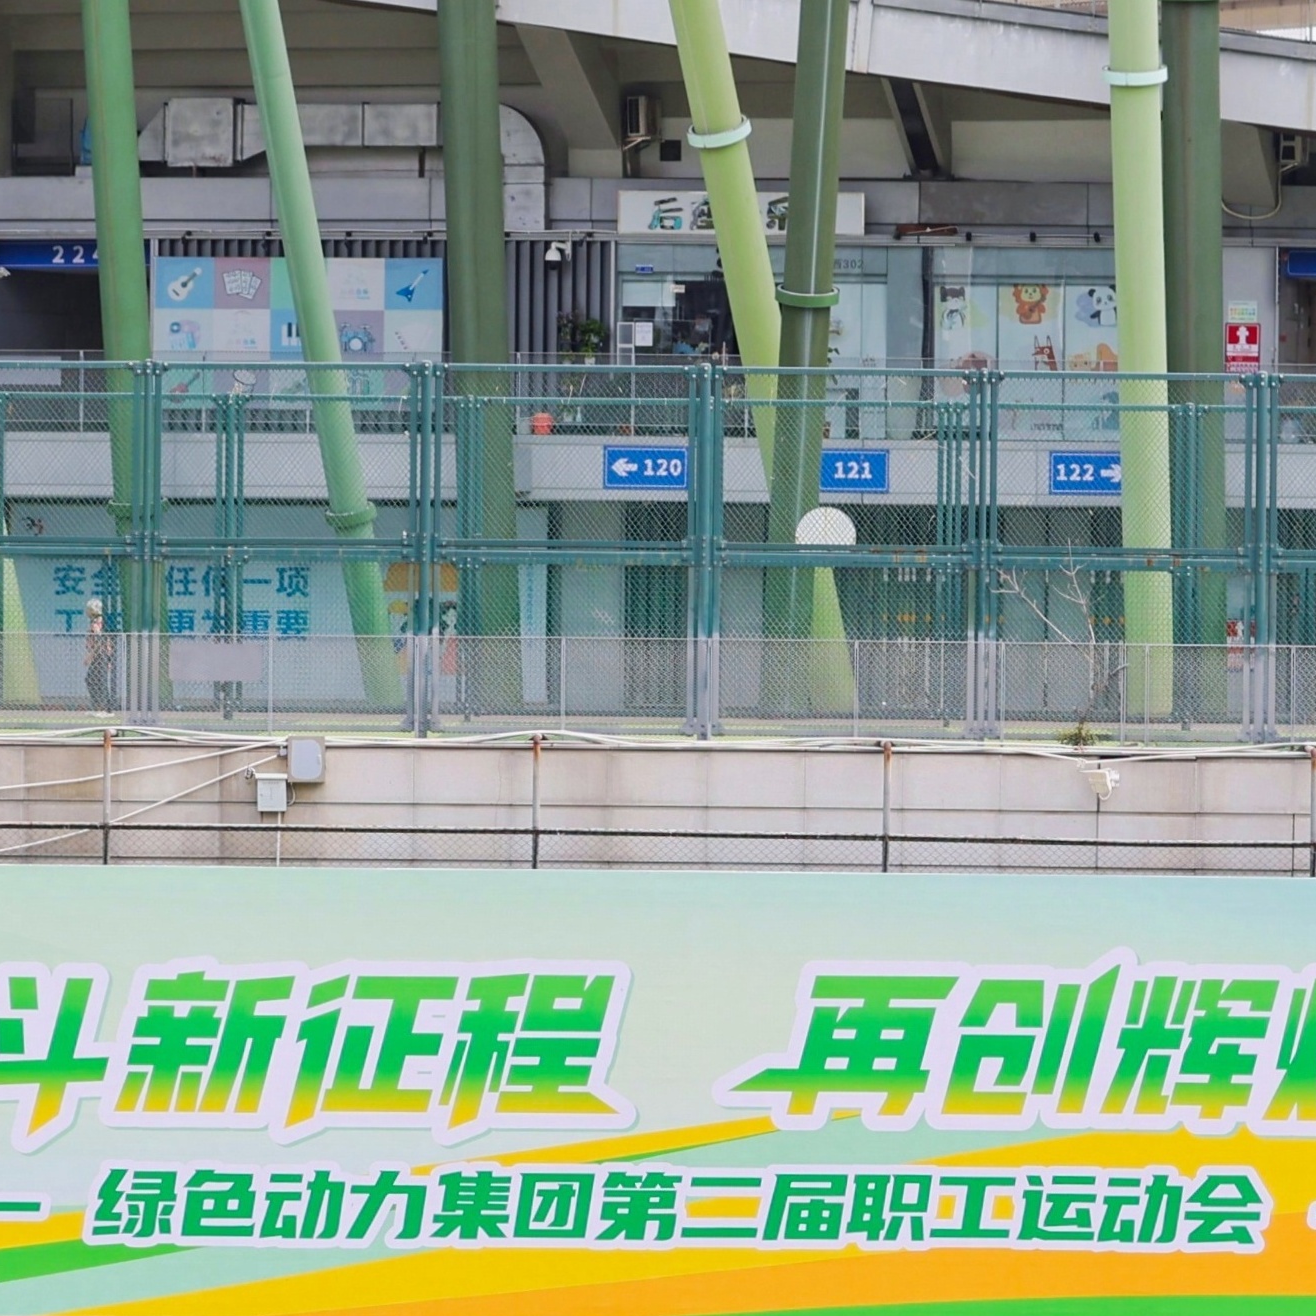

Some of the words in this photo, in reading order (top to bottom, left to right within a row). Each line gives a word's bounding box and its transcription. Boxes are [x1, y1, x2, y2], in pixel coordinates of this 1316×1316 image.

[648, 196, 789, 231] 后座乐
[643, 458, 682, 476] 120
[834, 461, 872, 479] 121
[1056, 463, 1095, 481] 122
[91, 1166, 1265, 1247] 绿色动力集团第二届职工运动会
